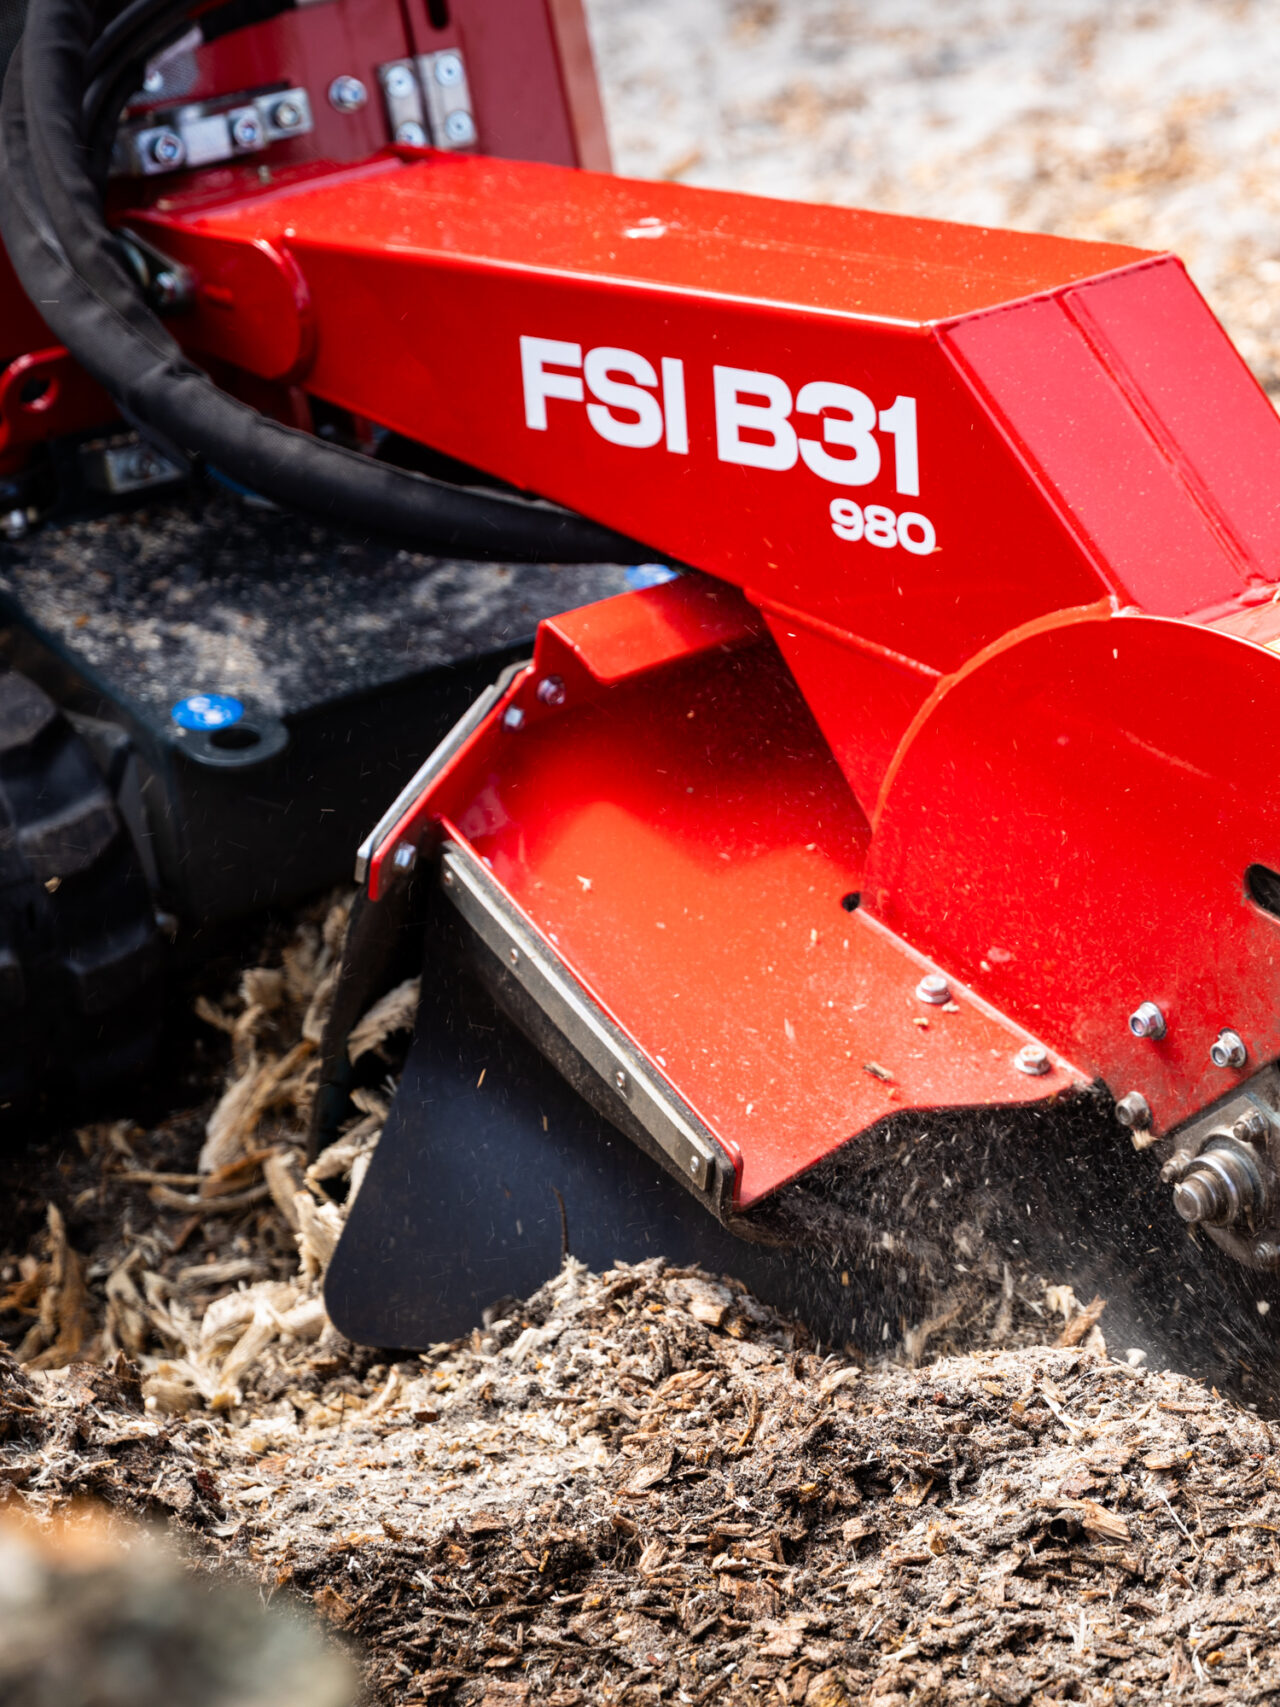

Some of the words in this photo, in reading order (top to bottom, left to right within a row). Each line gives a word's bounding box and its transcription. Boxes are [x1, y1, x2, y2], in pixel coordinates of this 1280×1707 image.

[520, 335, 689, 455] FSI
[713, 365, 920, 496] B31
[829, 498, 936, 555] 980
